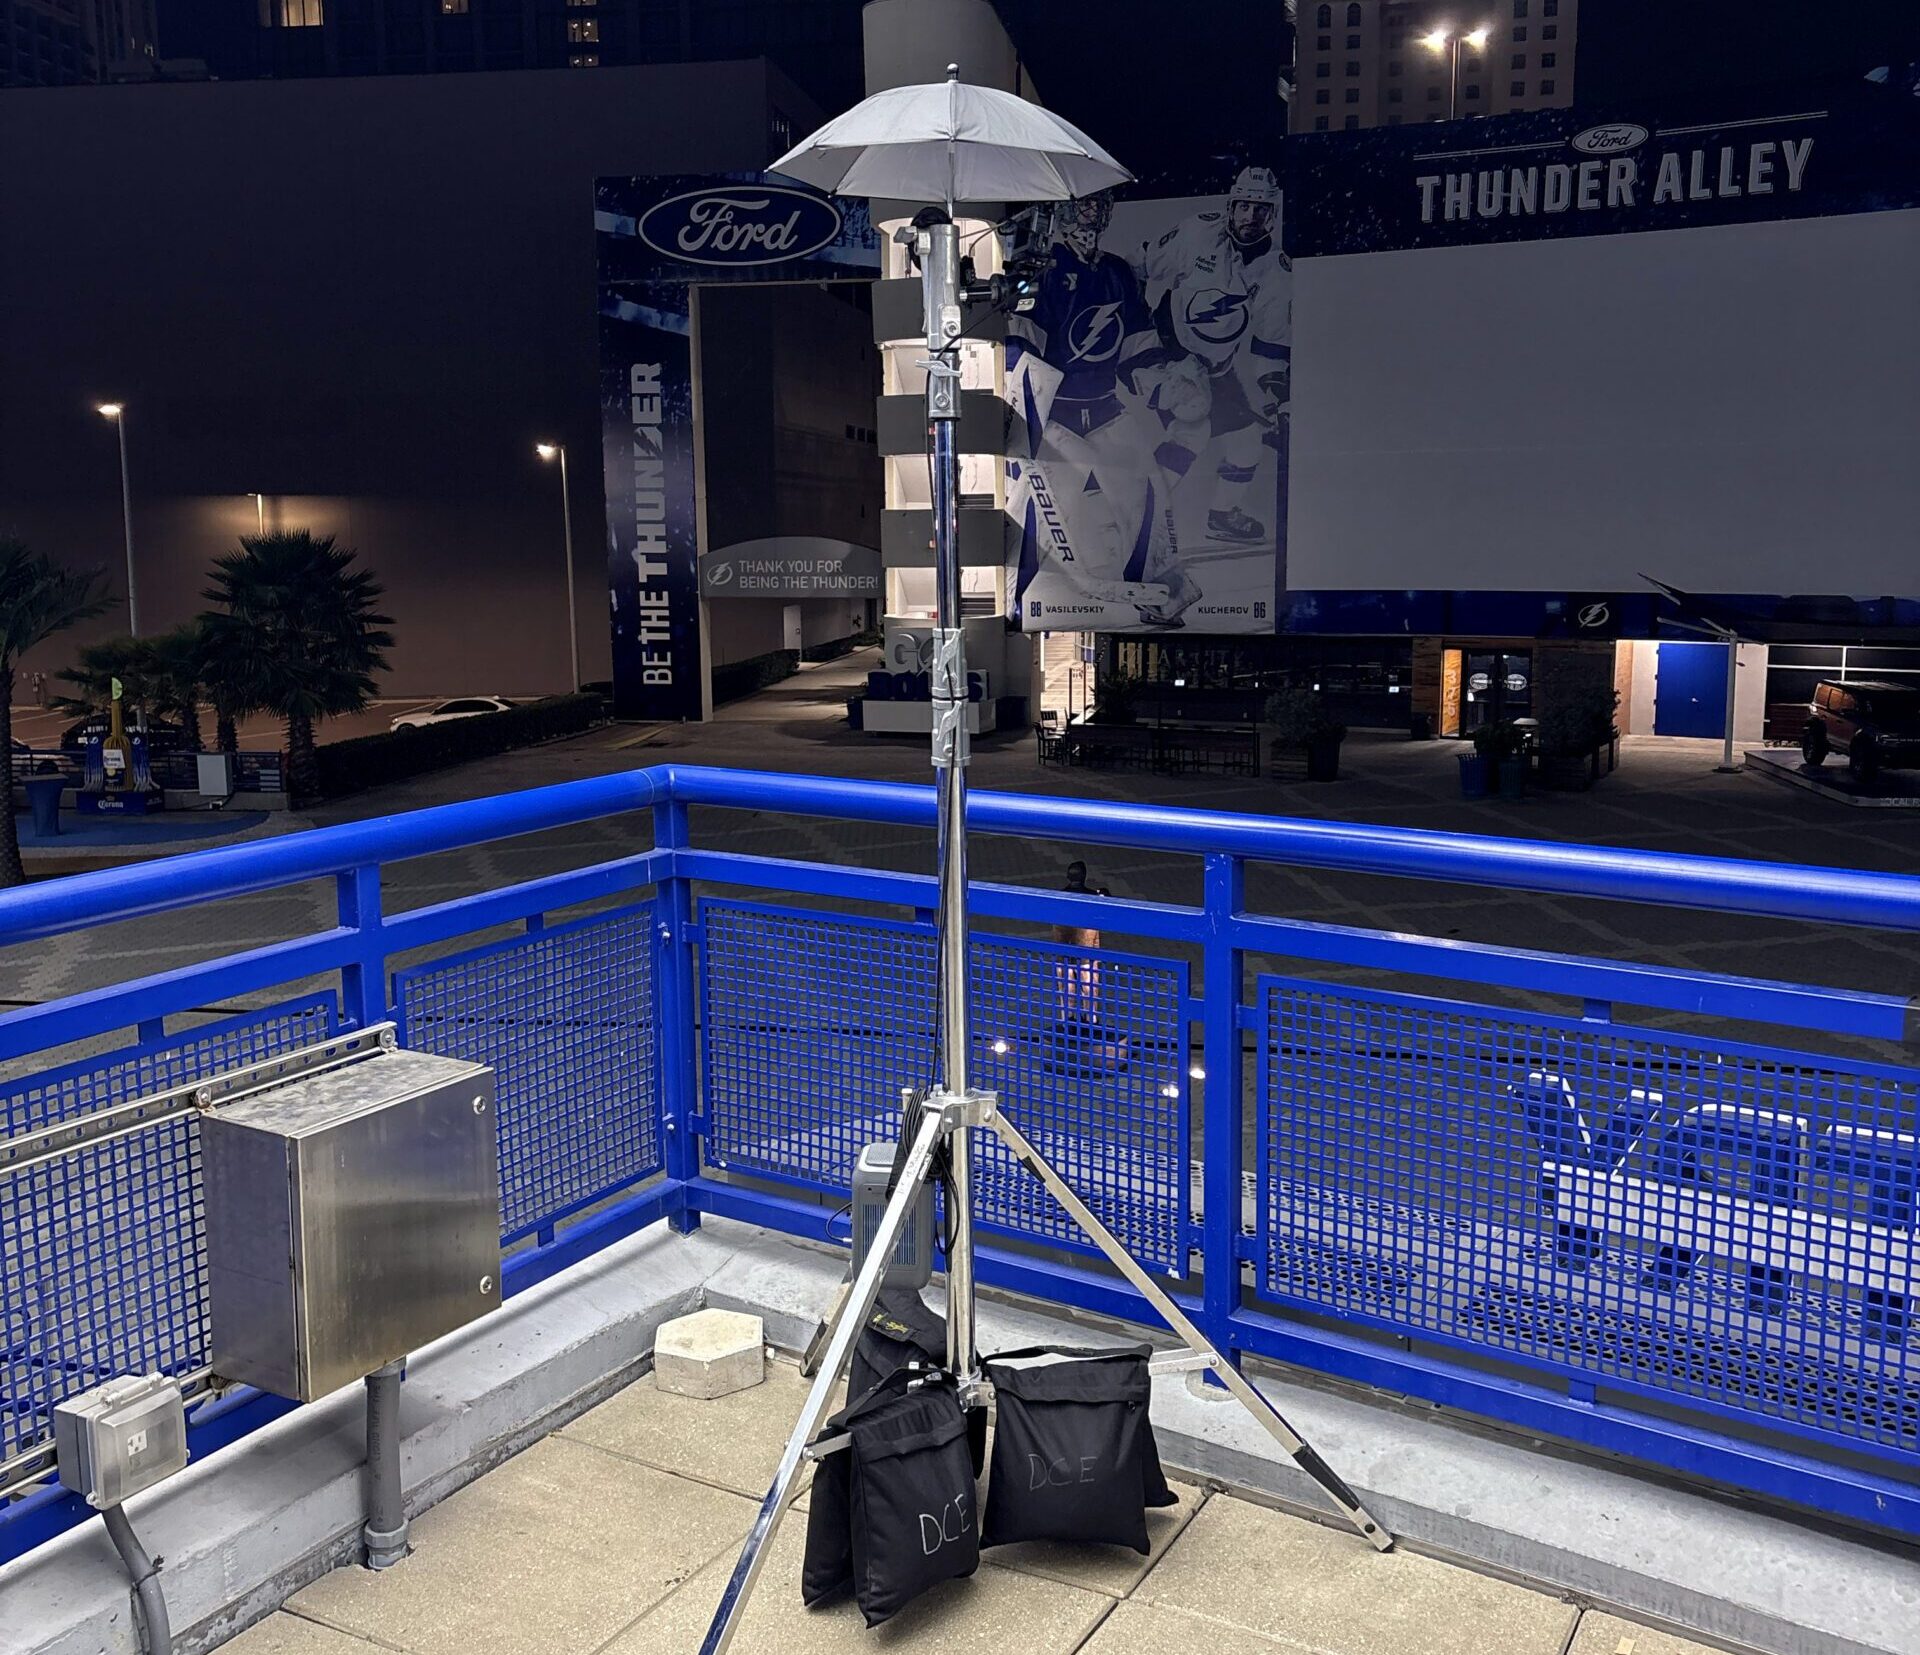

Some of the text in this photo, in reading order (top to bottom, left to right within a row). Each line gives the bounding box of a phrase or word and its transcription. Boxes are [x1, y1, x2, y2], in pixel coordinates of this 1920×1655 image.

[1587, 128, 1631, 148] Ford
[1415, 137, 1815, 224] THUNDER ALLEY
[677, 197, 801, 252] Ford
[630, 362, 672, 686] BE THE THUNDER
[1028, 474, 1075, 562] BAUER
[738, 560, 843, 573] THANK YOU FOR
[738, 575, 878, 589] BEING THE THUNDER!
[1030, 601, 1105, 618] 88 VASILEVSKIY
[1197, 601, 1267, 619] KUCHEROV 86
[98, 800, 123, 810] Corona
[1028, 1453, 1097, 1491] DCE
[918, 1493, 972, 1556] DCE
